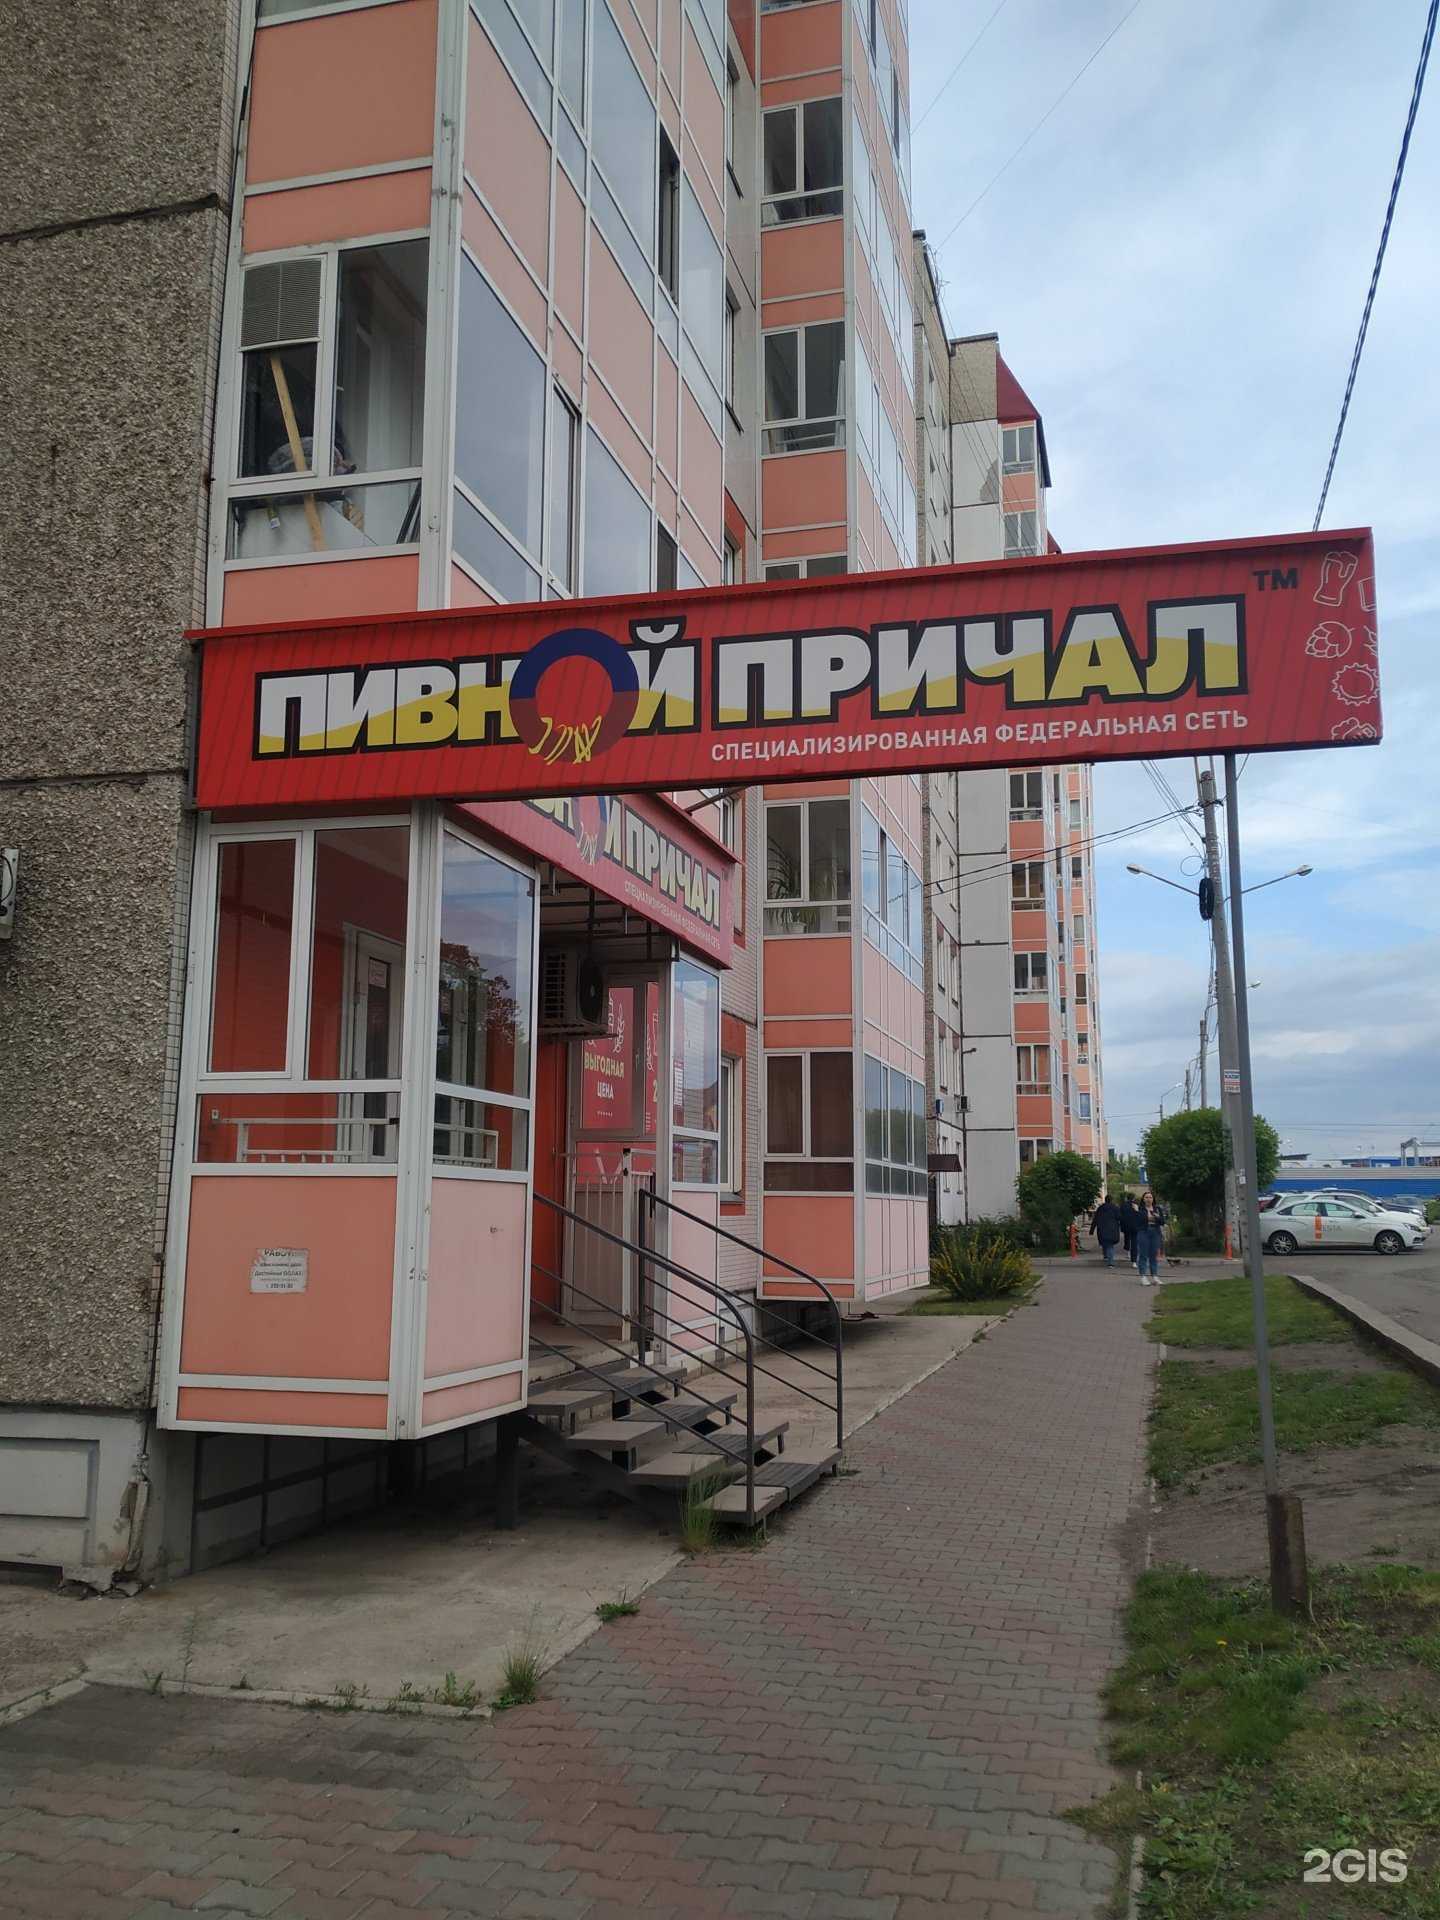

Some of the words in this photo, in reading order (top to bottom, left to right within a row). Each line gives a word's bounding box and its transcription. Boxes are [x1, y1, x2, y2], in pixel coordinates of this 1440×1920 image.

[253, 617, 702, 762] ПИВНОЙ
[711, 594, 1249, 730] ПРИЧАЛ
[711, 726, 987, 761] СПЕЦИАЛИЗИРОВАННАЯ
[995, 713, 1177, 744] ФЕДЕРАЛЬНАЯ
[1185, 710, 1248, 731] СЕТЬ
[623, 803, 721, 931] ПРИЧАЛ
[584, 1052, 624, 1079] ВЫГОДНАЯ
[597, 1080, 614, 1100] ЦЕНА
